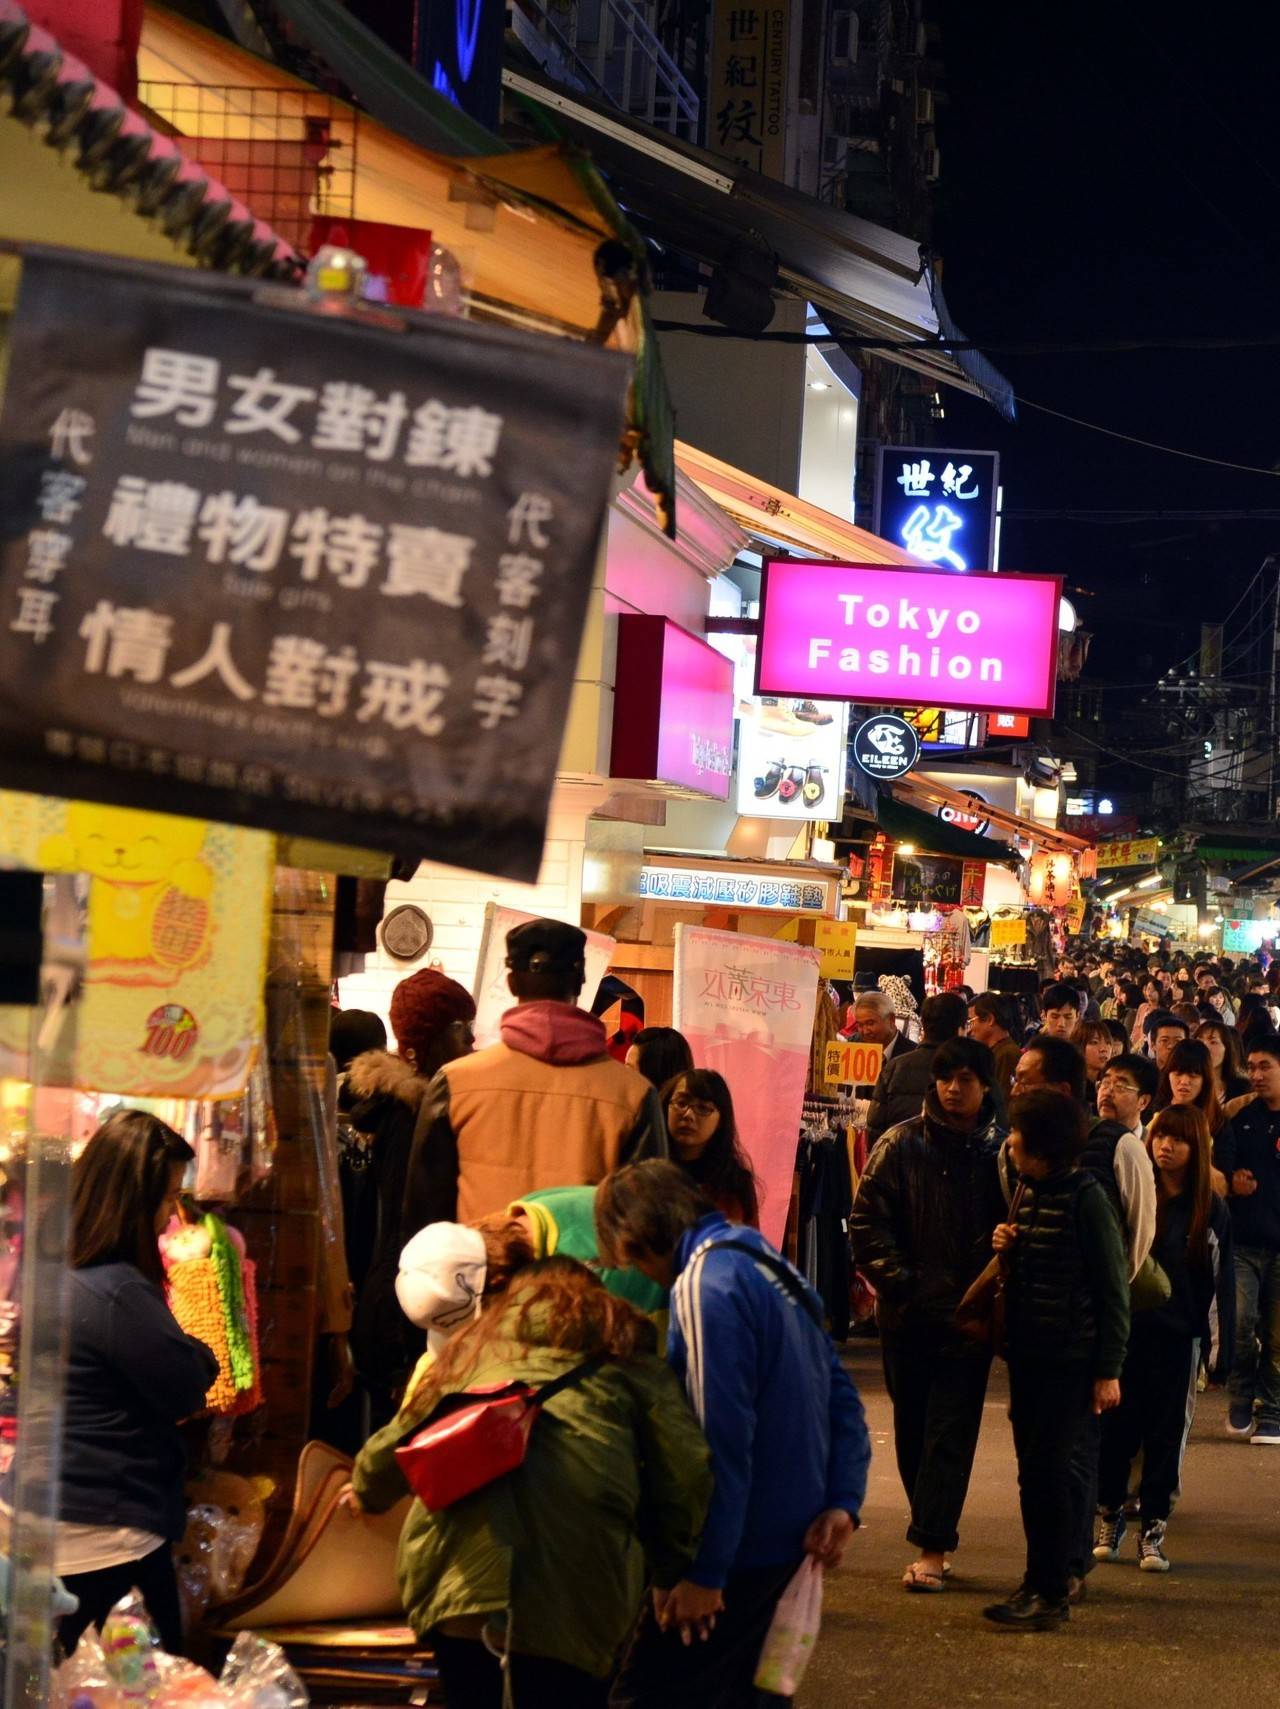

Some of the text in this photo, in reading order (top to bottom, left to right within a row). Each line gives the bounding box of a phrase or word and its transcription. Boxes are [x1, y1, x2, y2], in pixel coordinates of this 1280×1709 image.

[767, 9, 784, 136] CENTURY TATTOO
[897, 459, 980, 500] 世紀
[103, 474, 477, 608] 禮物特賣
[472, 490, 554, 730] 代客刻字
[837, 593, 981, 640] Tokyo
[79, 599, 451, 737] 情人對戒
[808, 638, 1003, 682] Fashion
[861, 753, 908, 767] EILEEN
[139, 1022, 198, 1060] 100
[827, 1050, 842, 1076] 特價
[842, 1049, 878, 1082] 100
